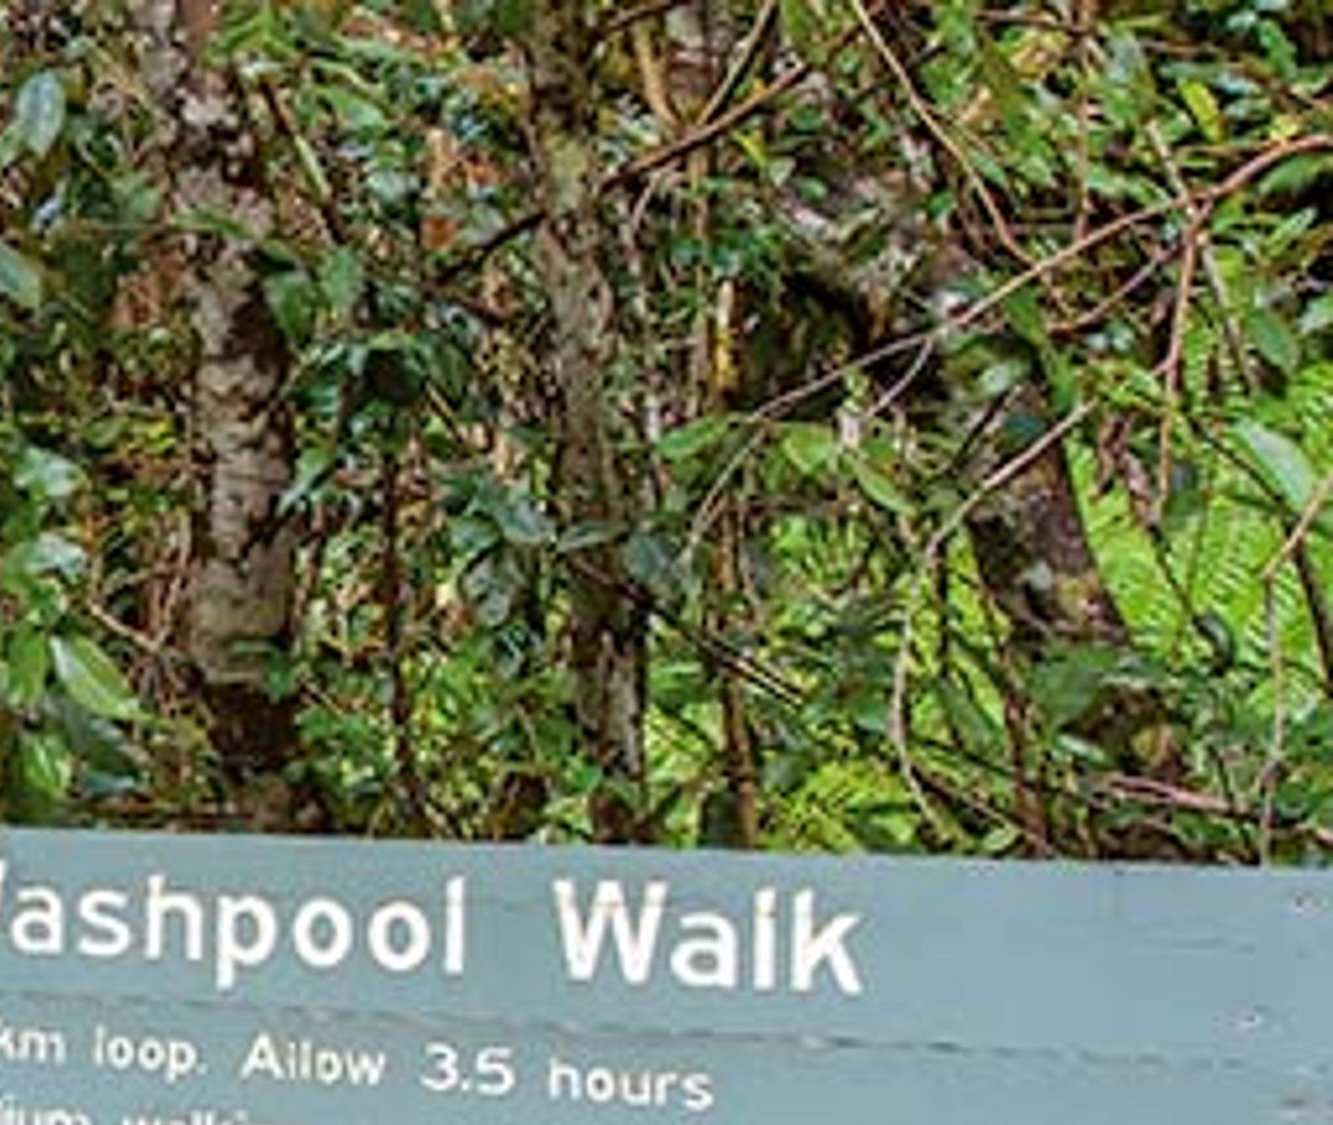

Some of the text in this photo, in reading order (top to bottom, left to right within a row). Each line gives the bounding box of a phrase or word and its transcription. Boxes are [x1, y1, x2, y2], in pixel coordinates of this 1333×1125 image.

[552, 878, 863, 996] Walk
[92, 1026, 207, 1084] loop.
[240, 1033, 387, 1086] Allow
[420, 1043, 517, 1096] 3.5
[547, 1058, 715, 1112] hours
